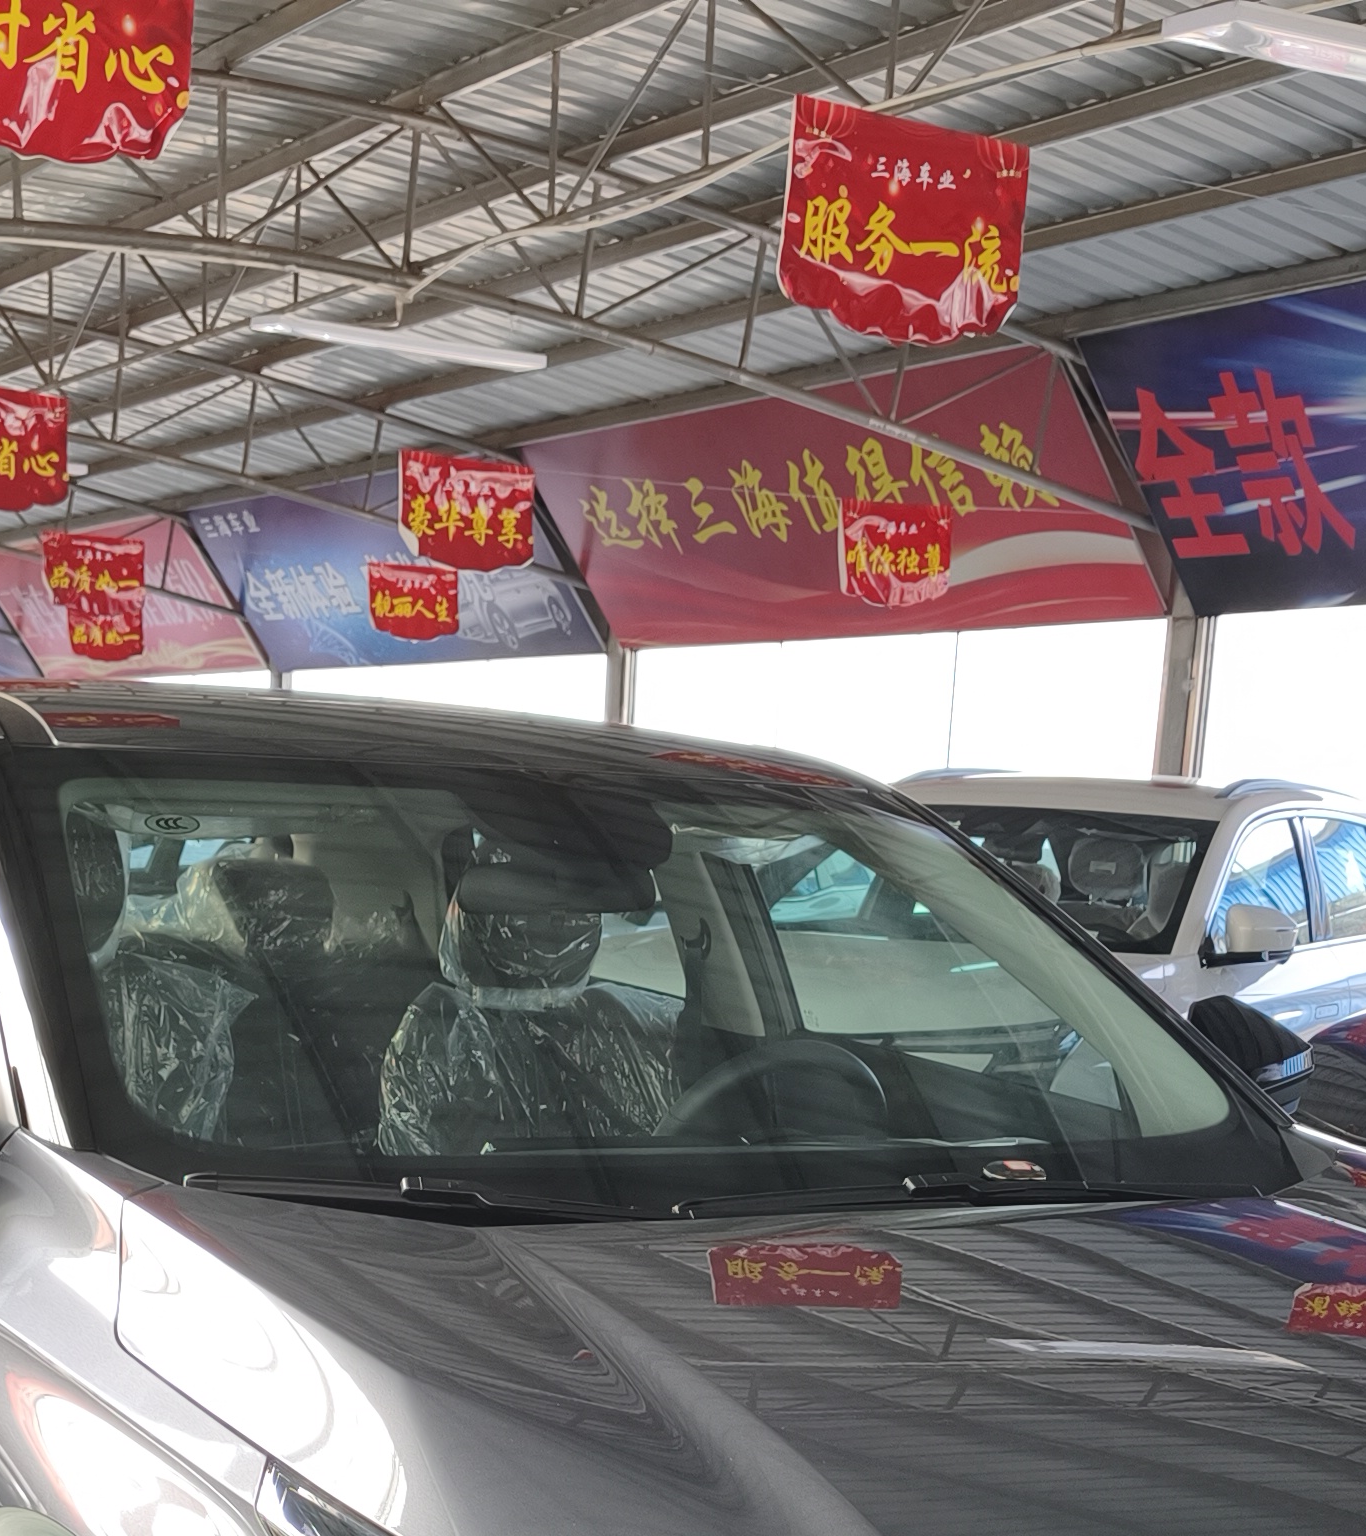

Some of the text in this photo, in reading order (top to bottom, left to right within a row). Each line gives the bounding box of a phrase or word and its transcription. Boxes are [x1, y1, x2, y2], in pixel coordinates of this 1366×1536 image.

[871, 156, 957, 191] 三海车业
[799, 195, 1007, 293] 服务一流
[1134, 368, 1357, 560] 全款
[581, 421, 1060, 556] 选择三海值得信赖
[408, 494, 523, 549] 豪华尊享
[49, 561, 140, 595] 品质如一
[846, 537, 945, 582] 唯你独尊
[371, 590, 452, 623] 靓丽人生
[72, 624, 140, 647] 品质如一
